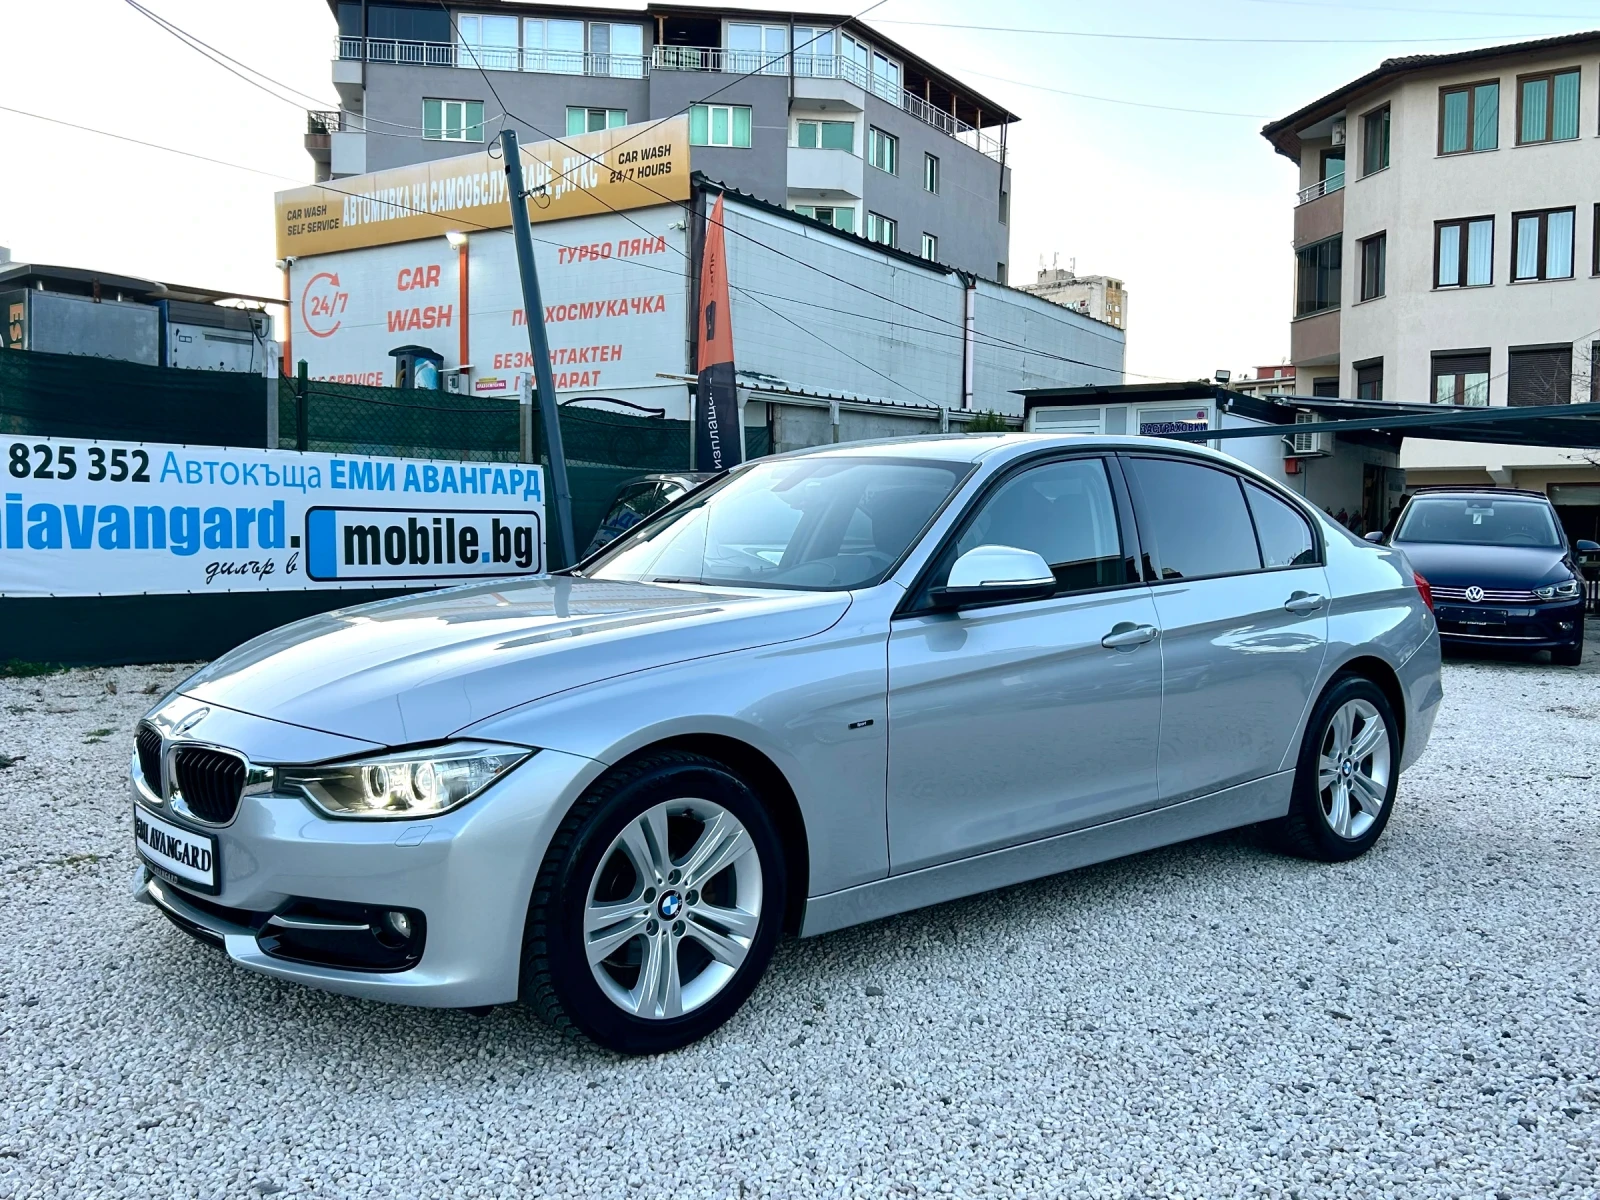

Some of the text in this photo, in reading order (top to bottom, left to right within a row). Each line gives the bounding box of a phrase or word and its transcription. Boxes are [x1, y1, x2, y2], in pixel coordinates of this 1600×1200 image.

[618, 144, 672, 165] CAR WASH
[609, 162, 672, 184] 24/7 HOURS
[286, 204, 327, 221] CAR WASH
[342, 186, 410, 227] АВТОМИВКА
[412, 182, 428, 216] НА
[287, 218, 340, 236] SELF SERVICE
[558, 236, 667, 265] ТУРБО ПЯНА
[397, 264, 441, 291] CAR
[311, 291, 349, 318] 24/7
[387, 304, 453, 333] WASH
[512, 294, 666, 327] ПХОСМУКАЧКА
[493, 344, 623, 370] БЕЗКНТАКТЕН
[9, 443, 541, 502] 825 352 Автокъща ЕМИ АВАНГАРД
[344, 517, 533, 568] mobile.bg
[149, 827, 212, 872] AVANGARD
